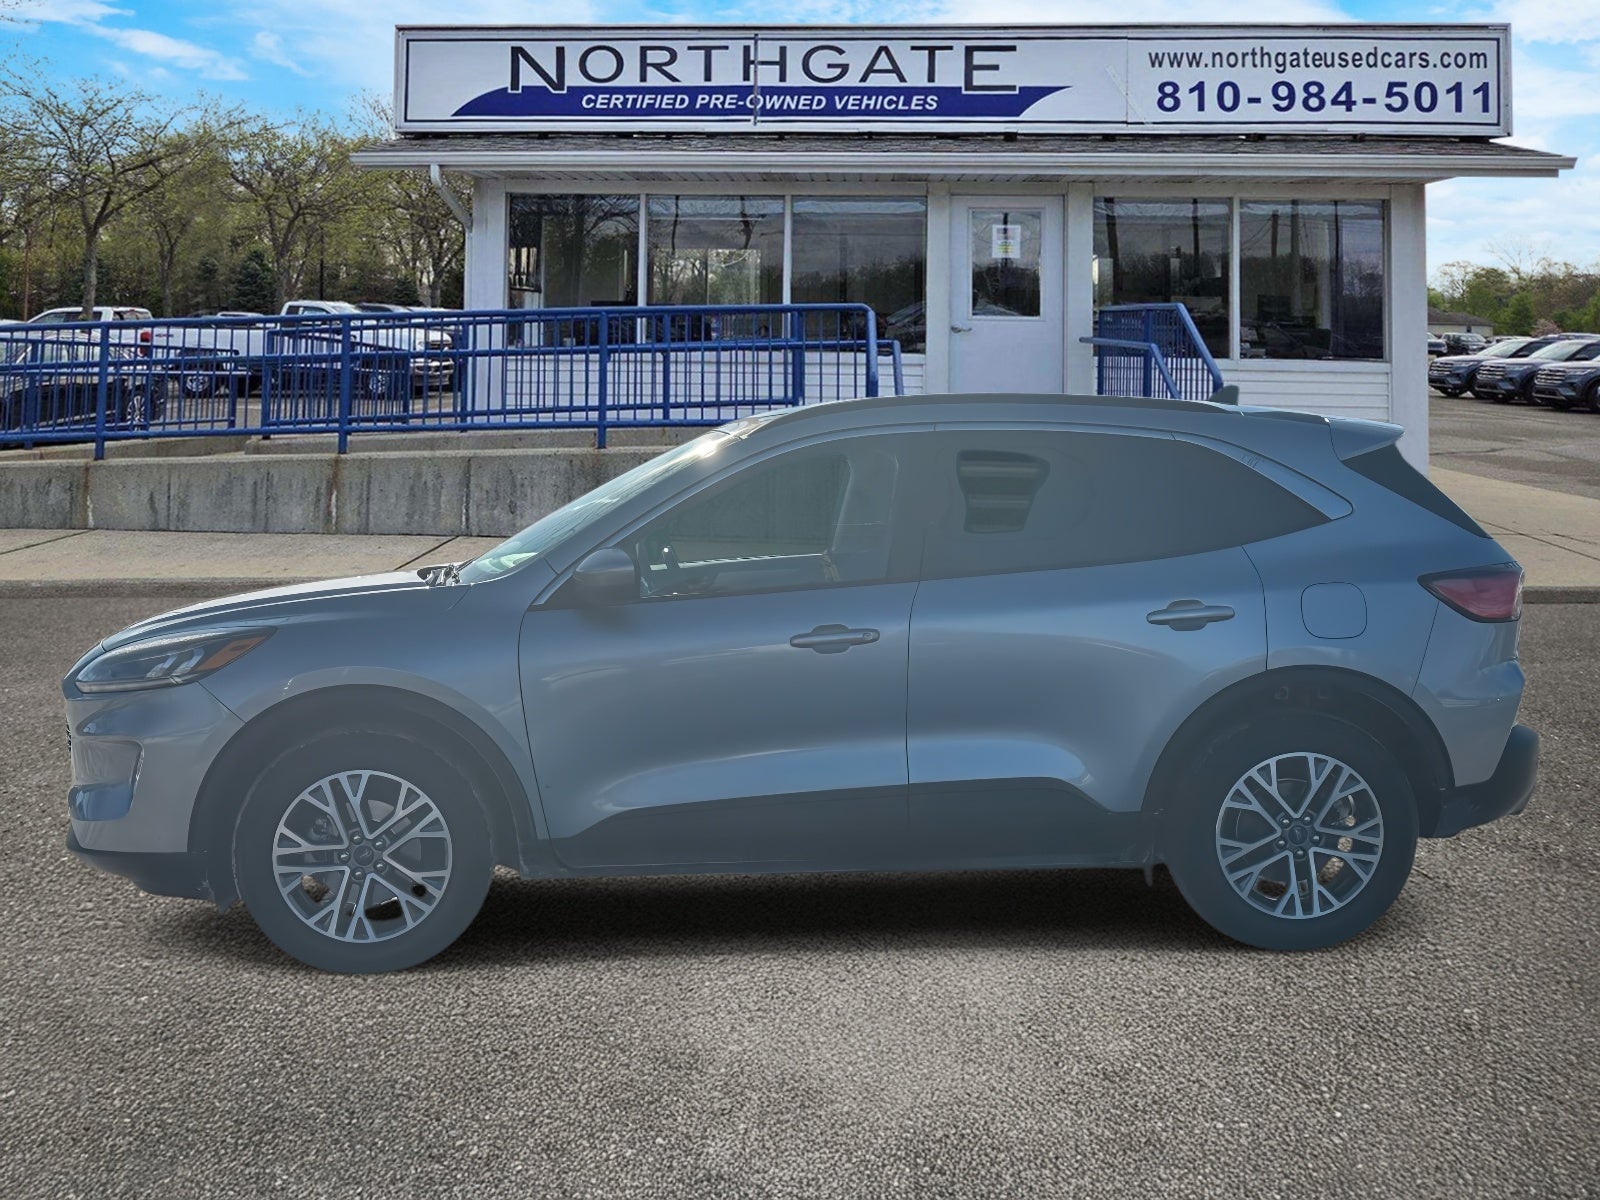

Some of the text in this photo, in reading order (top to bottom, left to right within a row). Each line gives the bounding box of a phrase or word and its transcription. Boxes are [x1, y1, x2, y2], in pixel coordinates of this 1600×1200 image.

[510, 45, 1017, 93] NORTHGATE
[1148, 46, 1488, 73] www.northgateusedcars.com
[581, 94, 939, 111] CERTIFIED PRE-OWNED VEHICLES
[1156, 80, 1491, 114] 810-984-5011
